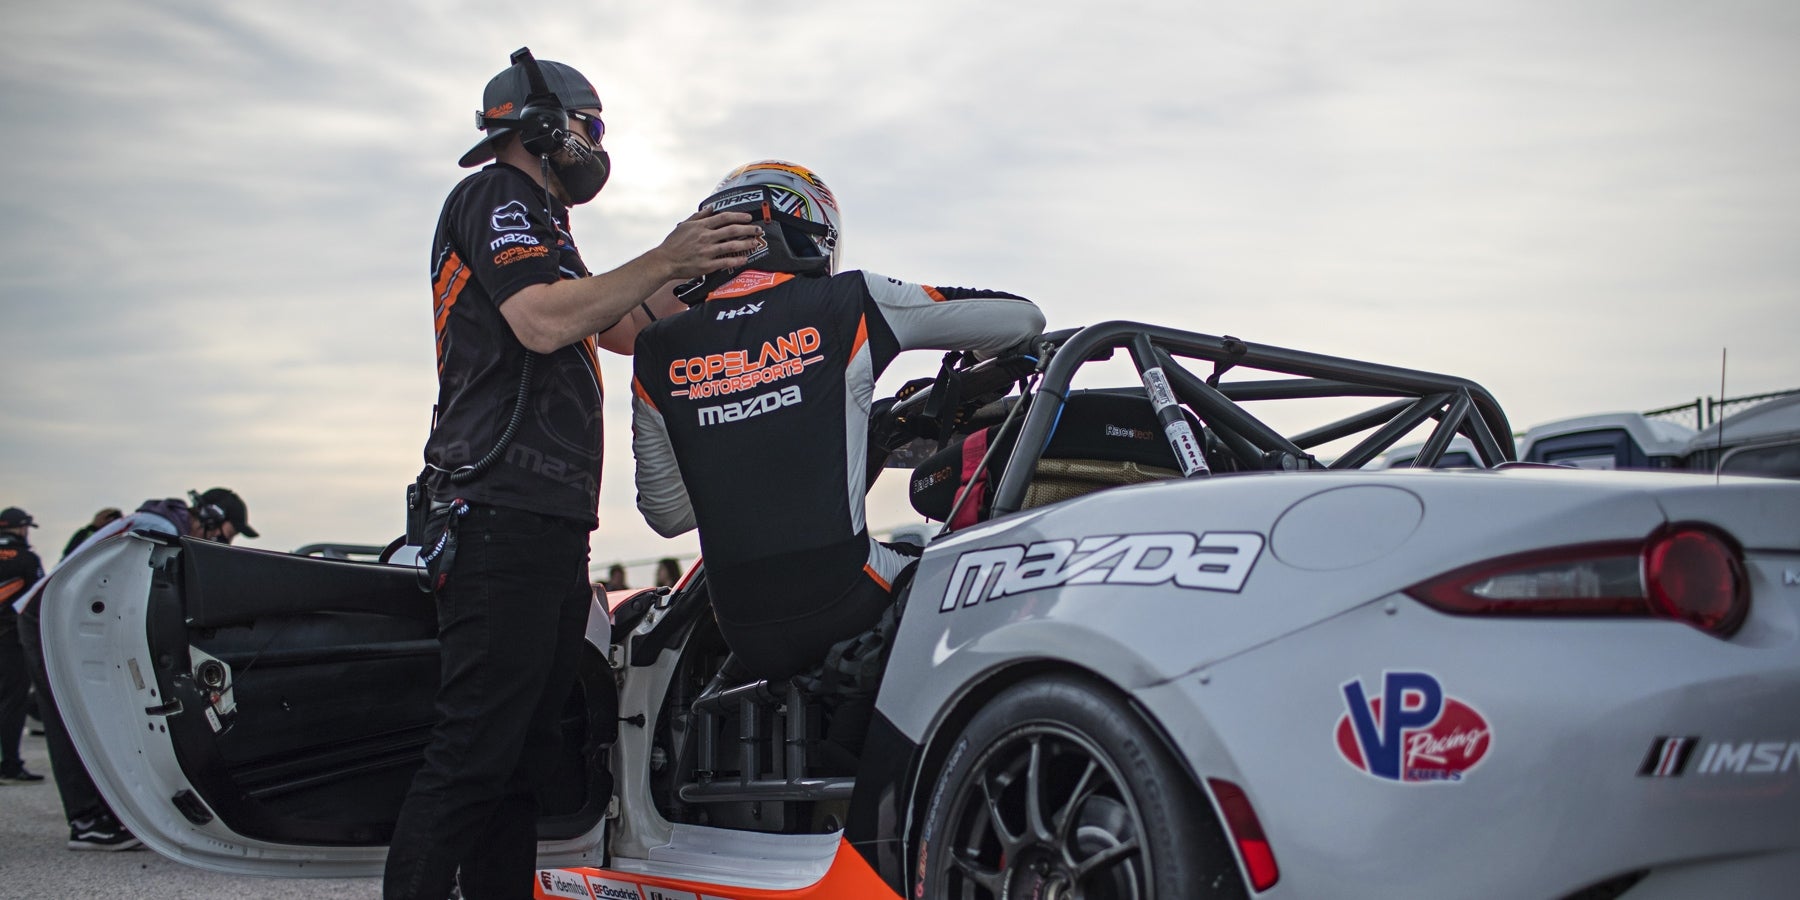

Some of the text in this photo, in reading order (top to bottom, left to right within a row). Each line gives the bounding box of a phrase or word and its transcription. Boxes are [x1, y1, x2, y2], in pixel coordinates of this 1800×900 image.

[494, 244, 549, 265] COPELAND
[669, 327, 821, 385] COPELAND
[688, 357, 804, 400] MOTORSPORTS
[1105, 424, 1154, 441] Racetech
[1181, 434, 1199, 466] 2021
[1341, 670, 1444, 782] VP
[1406, 726, 1490, 768] Racing
[1408, 768, 1463, 782] FUELS
[552, 874, 589, 897] idemitsu
[592, 883, 641, 900] BFGoodrich
